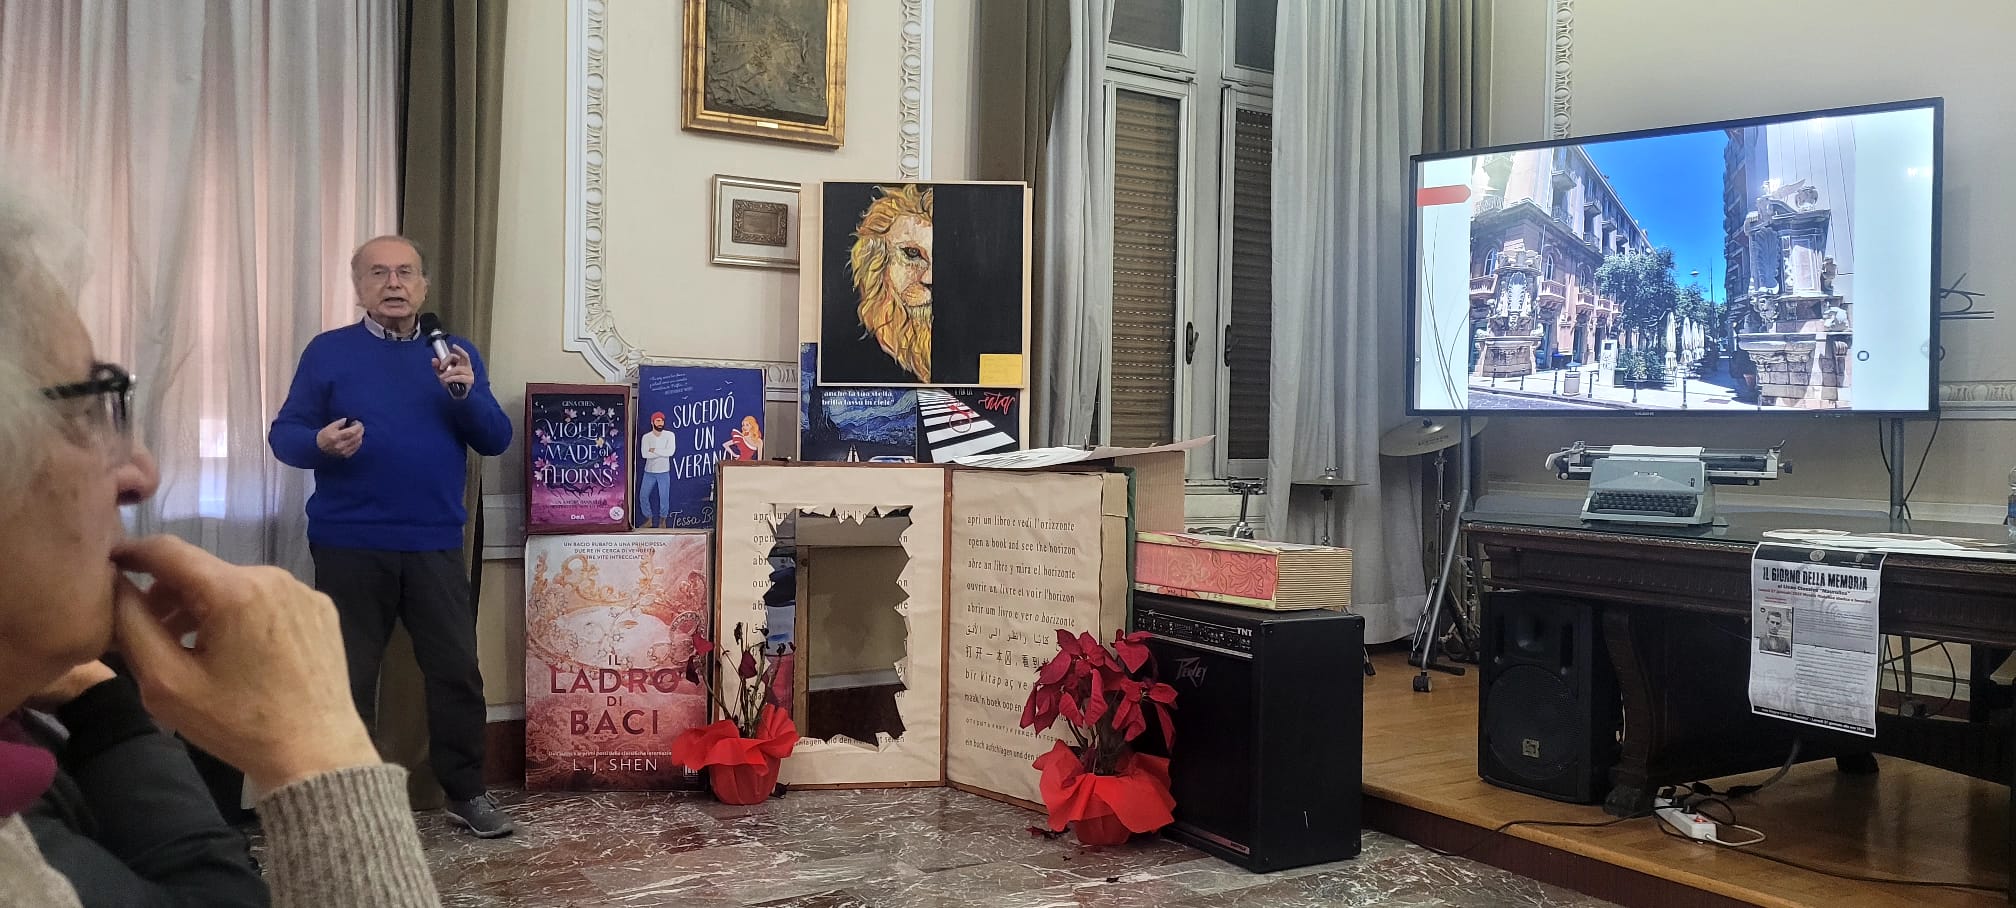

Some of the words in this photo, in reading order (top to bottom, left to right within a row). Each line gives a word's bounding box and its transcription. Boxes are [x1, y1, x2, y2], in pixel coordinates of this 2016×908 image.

[672, 391, 735, 429] SUCEDIÓ
[541, 420, 609, 440] VIOLET
[694, 426, 715, 451] UN
[545, 444, 598, 464] MADE
[541, 465, 614, 487] THORNS
[669, 508, 701, 530] Tessa
[967, 515, 981, 526] apri
[983, 517, 992, 525] un
[994, 515, 1010, 526] libro
[1018, 518, 1032, 528] vedi
[1034, 518, 1075, 531] l'orizzonte
[968, 538, 984, 548] open
[991, 537, 1007, 549] book
[1008, 540, 1019, 550] and
[1021, 542, 1033, 551] see
[1036, 541, 1047, 552] the
[1048, 542, 1076, 555] horizon
[968, 558, 982, 568] abre
[994, 560, 1008, 571] libro
[1010, 565, 1014, 575] y
[1016, 563, 1031, 574] mira
[1034, 565, 1041, 575] el
[1043, 565, 1076, 579] horizonte
[1763, 567, 1769, 580] IL
[1771, 568, 1801, 584] GIORNO
[1803, 570, 1825, 587] DELLA
[1827, 573, 1868, 591] MEMORIA
[966, 581, 987, 592] ouvrir
[999, 583, 1016, 596] livre
[1026, 588, 1042, 598] voir
[1044, 588, 1075, 603] l'horizon
[967, 602, 984, 614] abrir
[985, 606, 996, 616] um
[998, 606, 1013, 618] livro
[1014, 611, 1018, 619] e
[1021, 613, 1032, 621] ver
[1034, 614, 1039, 622] o
[1040, 612, 1075, 627] horizonte
[1237, 627, 1253, 637] TNT
[608, 654, 621, 666] IL
[550, 668, 680, 694] LADRO
[965, 668, 977, 680] bir
[980, 671, 1002, 688] kitap
[1004, 679, 1014, 690] aç
[1017, 681, 1028, 691] ve
[606, 696, 622, 707] DI
[986, 696, 1002, 708] boek
[1002, 701, 1014, 711] oop
[1014, 704, 1022, 712] en
[570, 710, 659, 735] BACI
[573, 758, 587, 771] L.
[591, 758, 603, 775] J.
[608, 758, 658, 771] SHEN
